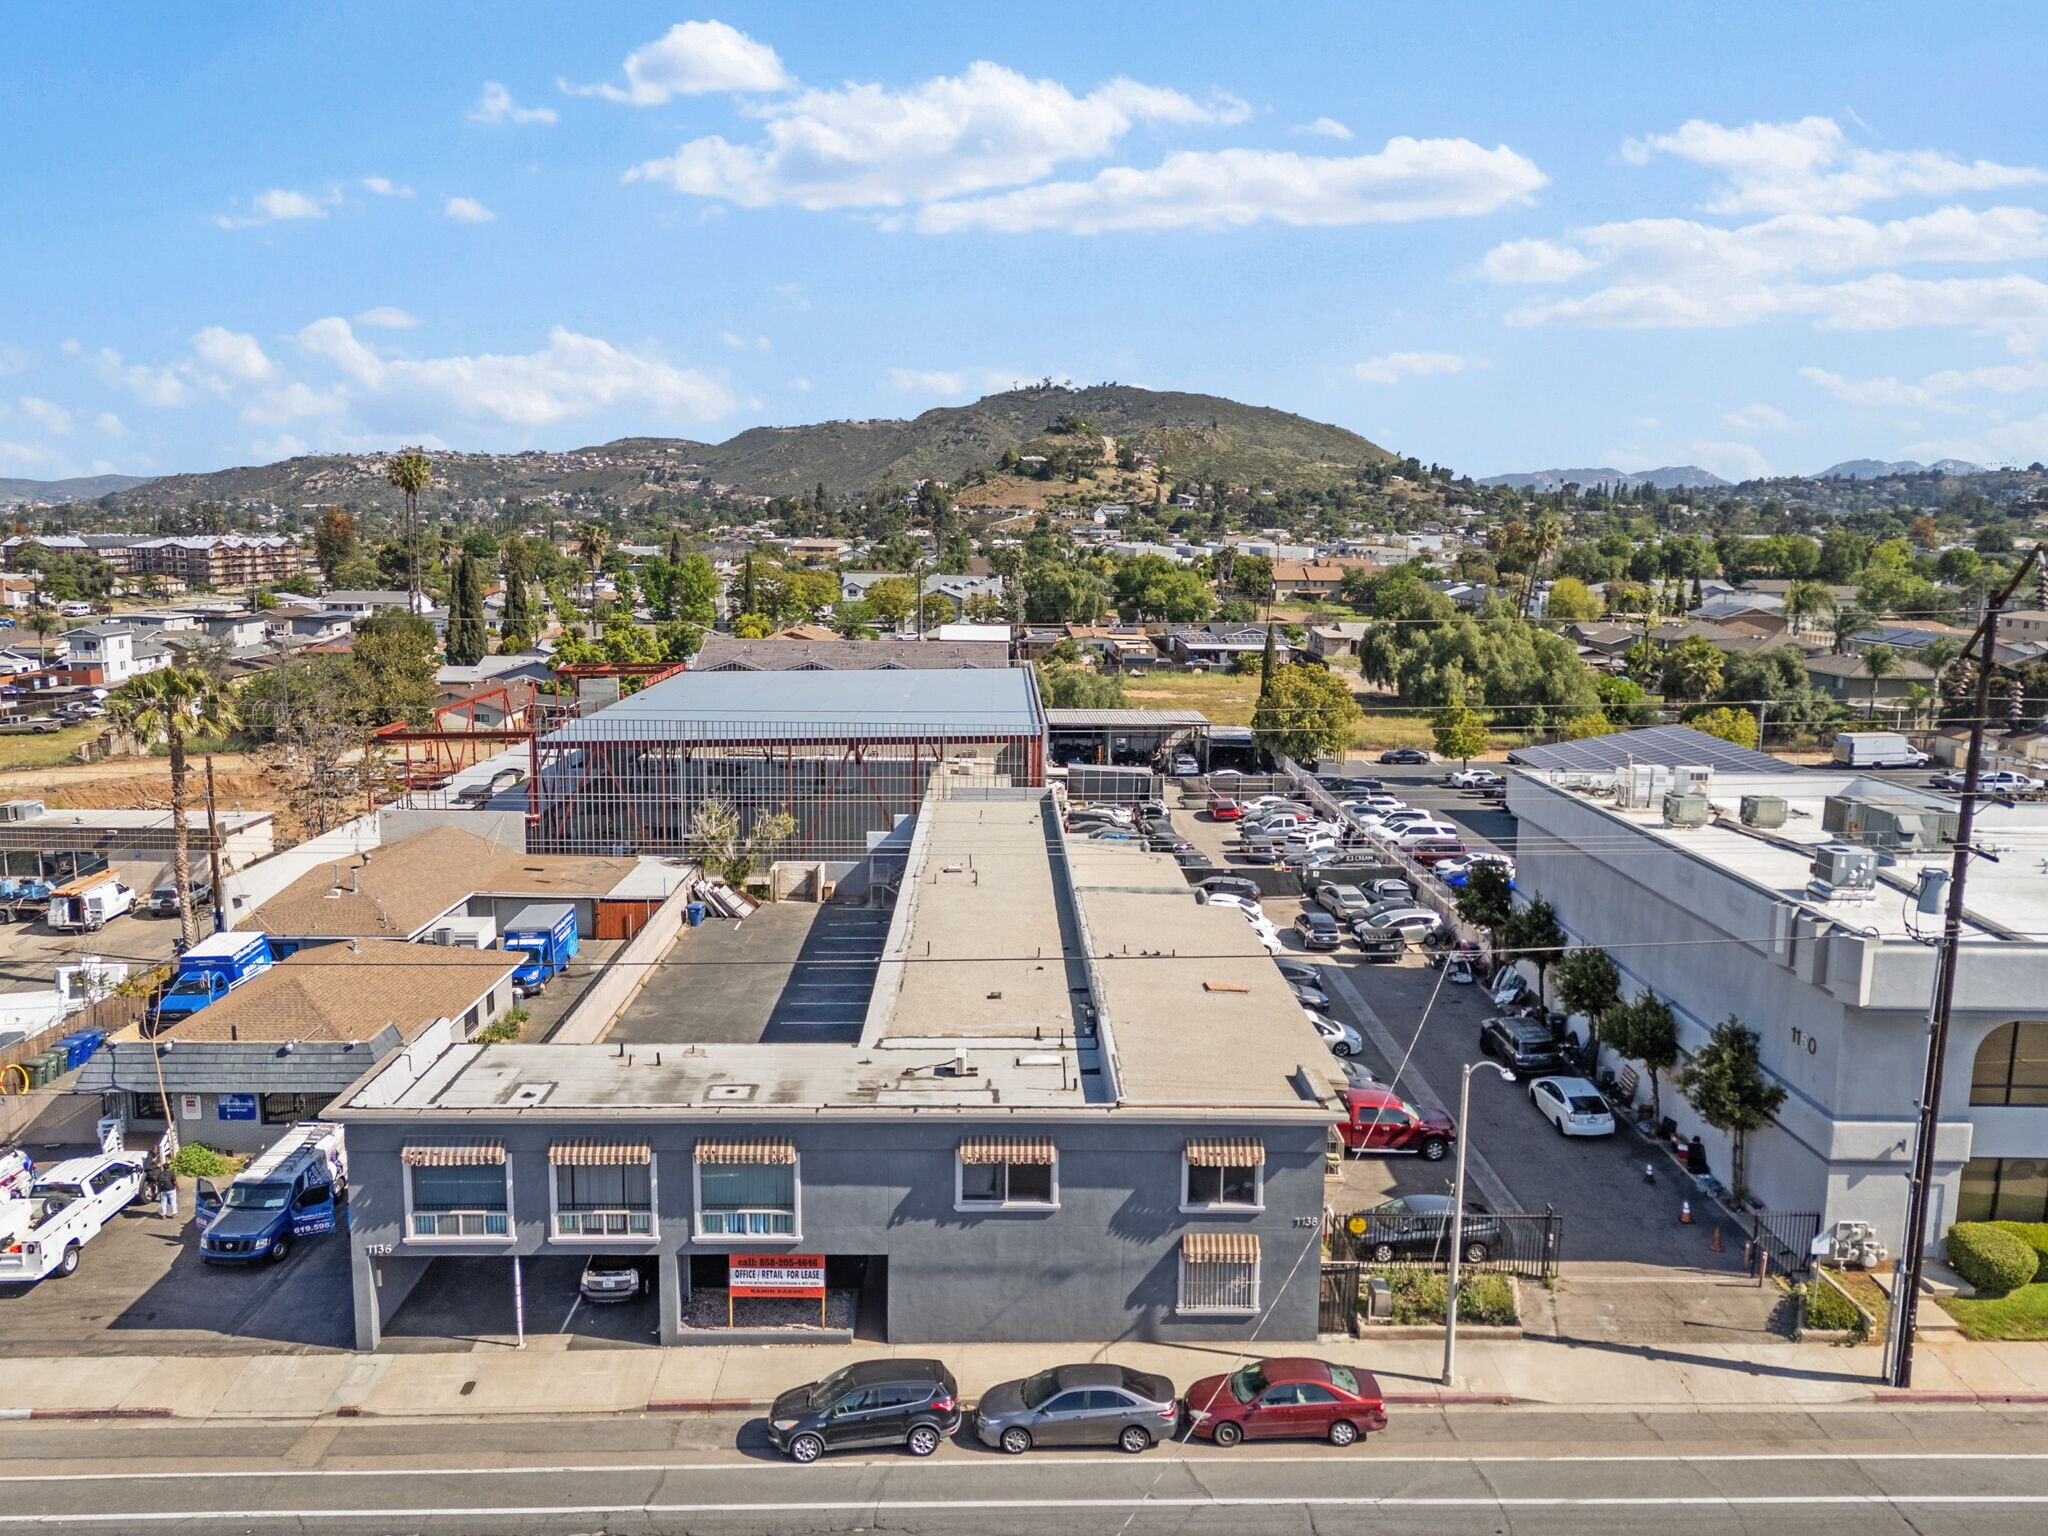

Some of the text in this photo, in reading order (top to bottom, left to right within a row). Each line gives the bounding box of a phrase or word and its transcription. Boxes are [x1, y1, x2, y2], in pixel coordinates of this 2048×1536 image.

[1295, 1216, 1318, 1226] 1138
[294, 1222, 335, 1234] 619.598.
[367, 1244, 392, 1254] 1136
[738, 1258, 757, 1267] call:
[734, 1270, 756, 1279] OFFICE
[762, 1270, 784, 1280] RETAIL
[786, 1270, 800, 1280] FOR
[801, 1270, 820, 1280] LEASE
